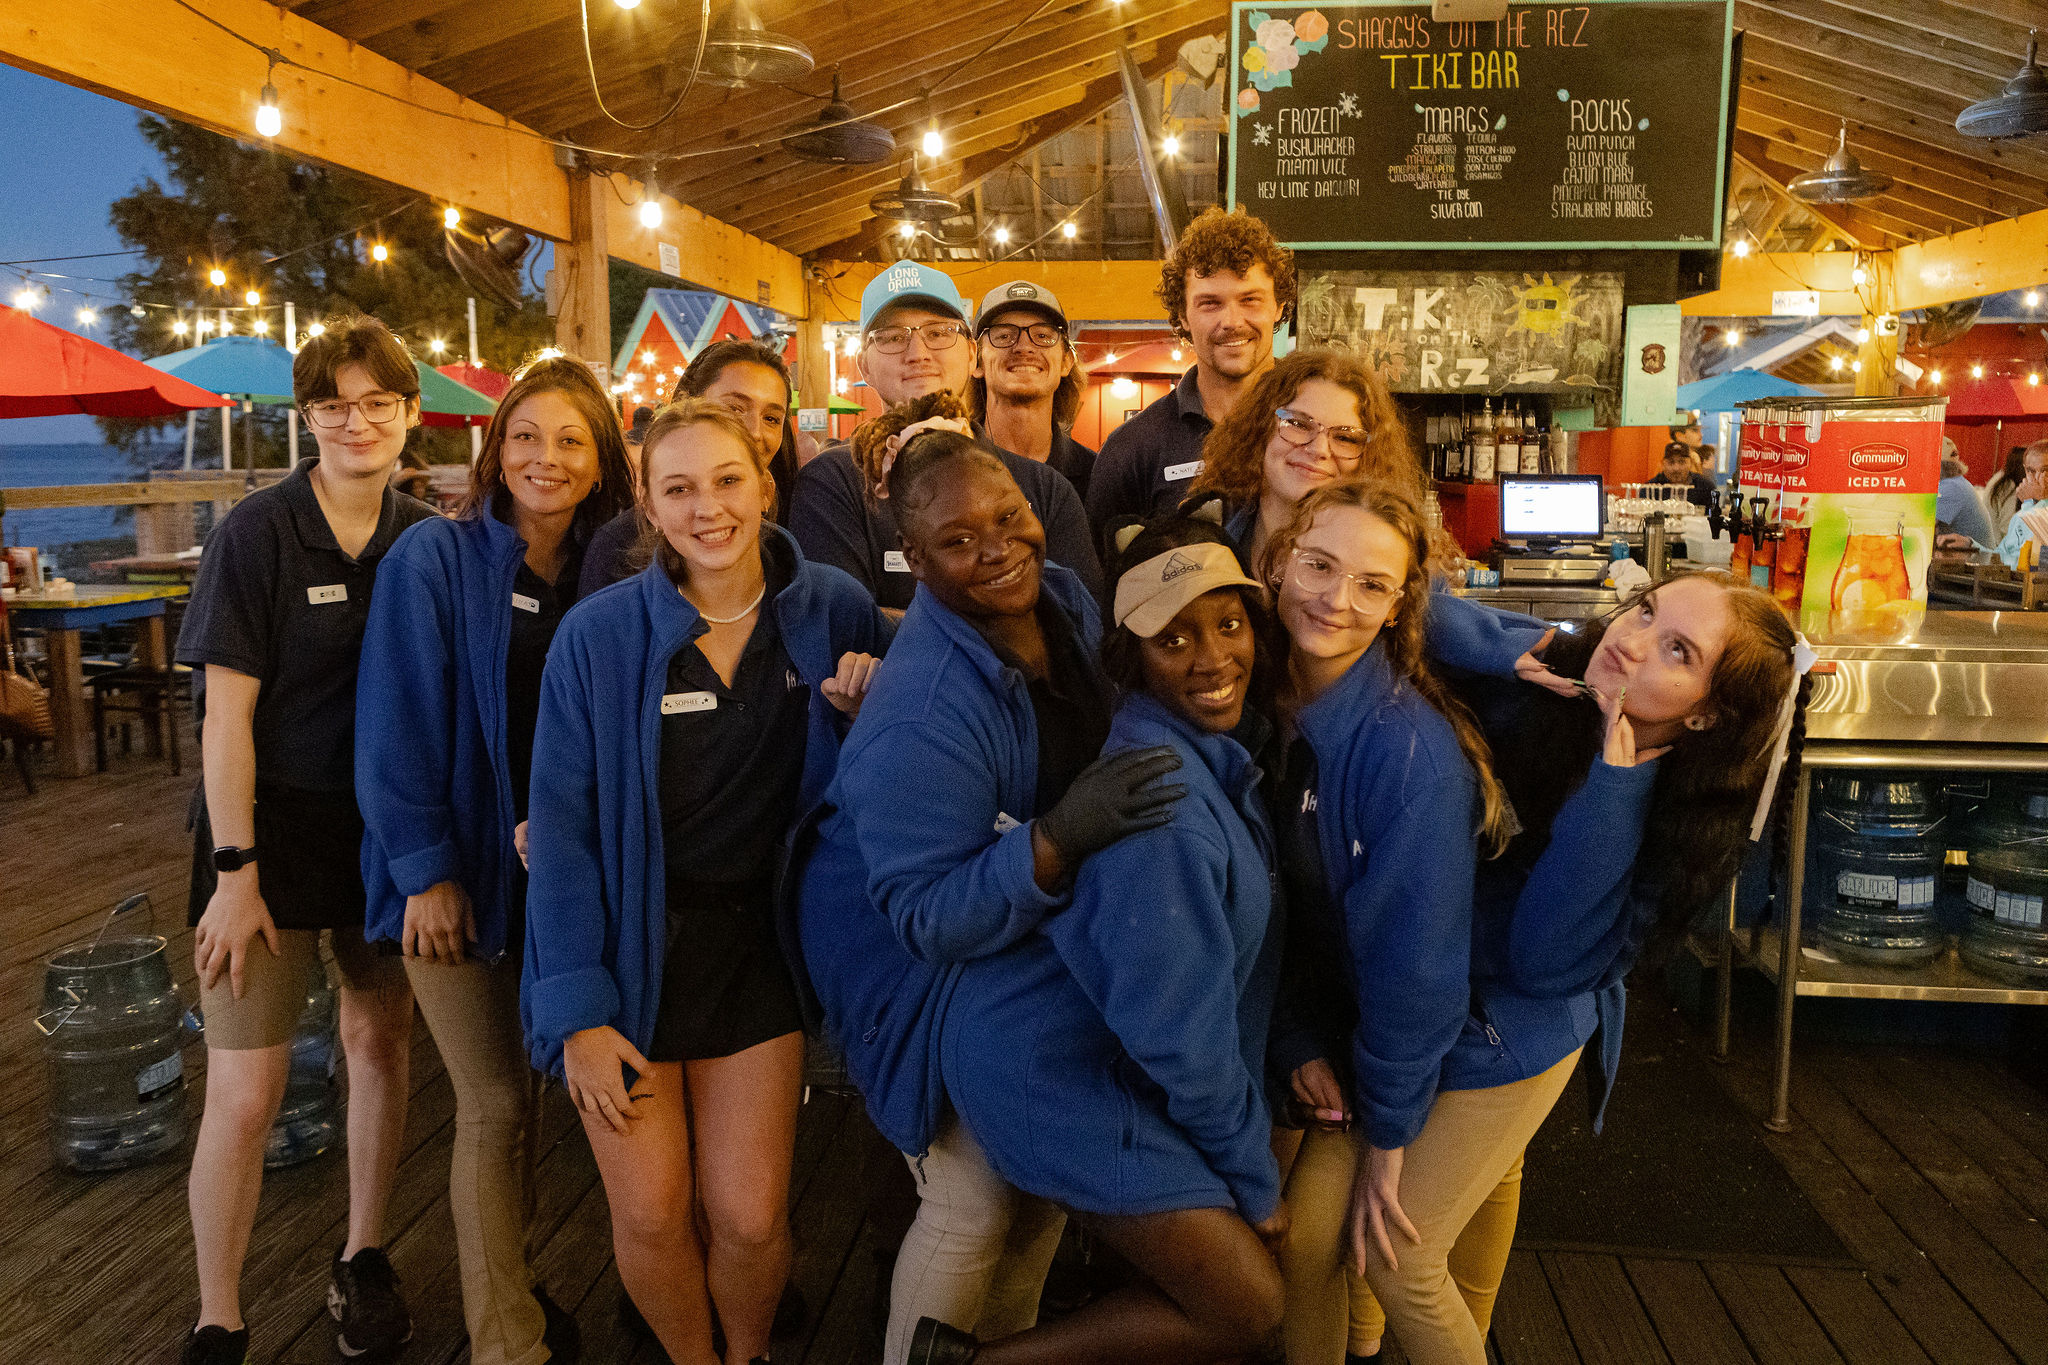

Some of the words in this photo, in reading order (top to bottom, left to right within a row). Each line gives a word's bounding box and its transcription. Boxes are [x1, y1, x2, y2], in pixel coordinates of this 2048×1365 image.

[1338, 13, 1430, 49] SHAGGY'S
[1546, 7, 1590, 48] REZ
[1380, 52, 1463, 90] TIKI
[1471, 50, 1520, 89] BAR
[1278, 106, 1340, 135] FROZEN
[1425, 106, 1489, 133] MARGS
[1571, 98, 1633, 133] ROCKS
[1277, 136, 1355, 157] BUSHWHACKER
[1417, 133, 1453, 144] FLAVORS
[1567, 135, 1597, 150] RUM
[1600, 135, 1635, 150] PUNCH
[1277, 159, 1319, 176] MIAMI
[1322, 158, 1347, 176] VICE
[1569, 151, 1605, 168] BILOXI
[1607, 151, 1630, 168] BLUE
[1563, 167, 1599, 184] CAJUN
[1603, 166, 1634, 184] MARY
[1258, 181, 1277, 199] KEY
[1280, 181, 1311, 199] LIME
[1436, 189, 1453, 200] TIE
[1456, 189, 1471, 200] DYE
[1552, 184, 1598, 201] PINEAPPLE
[1603, 184, 1649, 201] PARADISE
[1430, 203, 1463, 220] SILVER
[1464, 201, 1483, 218] COIN
[1551, 202, 1611, 219] STRAWBERRY
[1615, 200, 1654, 218] BUBBLES
[888, 267, 919, 282] LONG
[887, 277, 923, 293] DRINK
[1851, 451, 1906, 466] Community
[1763, 473, 1781, 484] TEA
[1787, 475, 1808, 487] TEA
[1848, 476, 1881, 488] ICED
[1882, 476, 1907, 488] TEA
[1161, 562, 1203, 582] adidas
